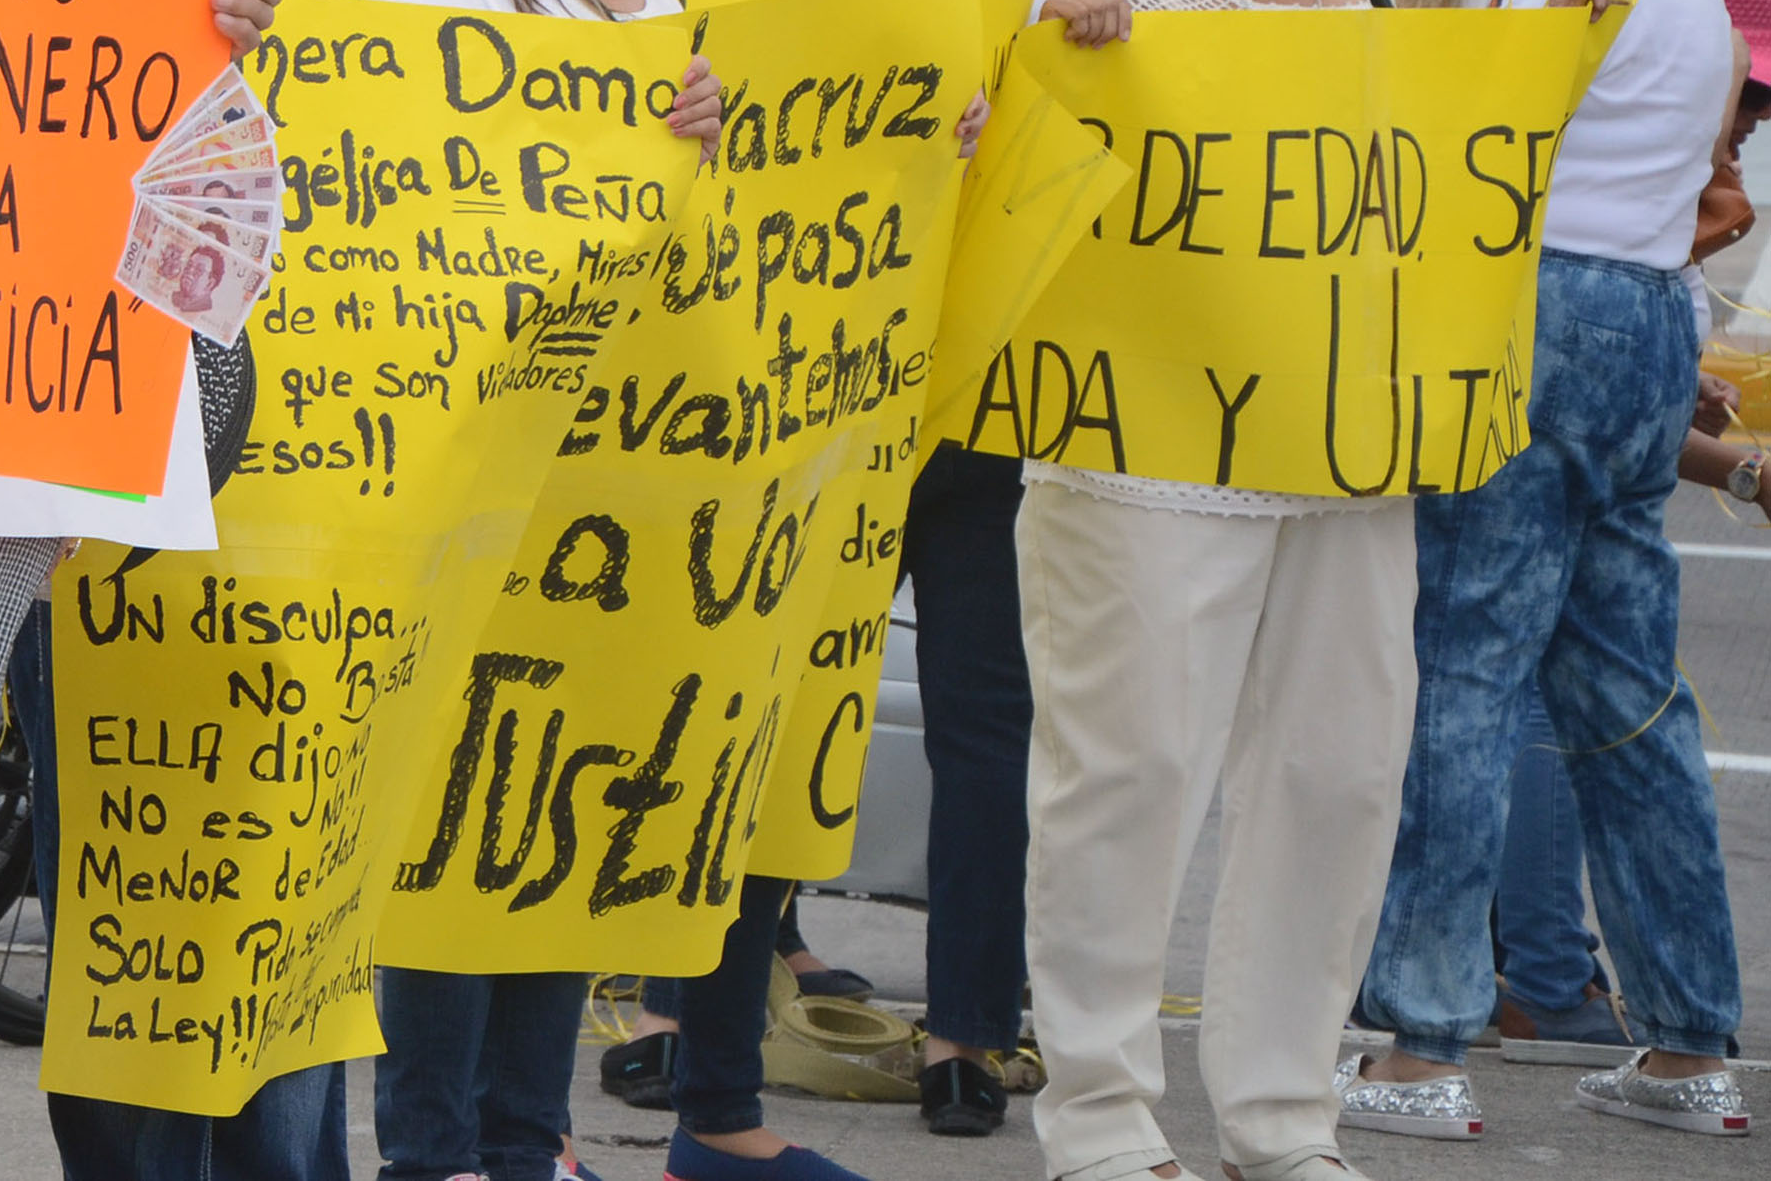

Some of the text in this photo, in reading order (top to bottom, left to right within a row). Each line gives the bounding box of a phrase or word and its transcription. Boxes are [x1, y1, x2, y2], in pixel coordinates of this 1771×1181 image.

[1130, 127, 1233, 255] DE
[303, 244, 400, 273] como
[392, 283, 489, 369] hija
[281, 364, 353, 430] que
[1204, 366, 1261, 486] Y
[87, 715, 224, 784] ELLA
[201, 809, 274, 841] es
[274, 846, 312, 902] de
